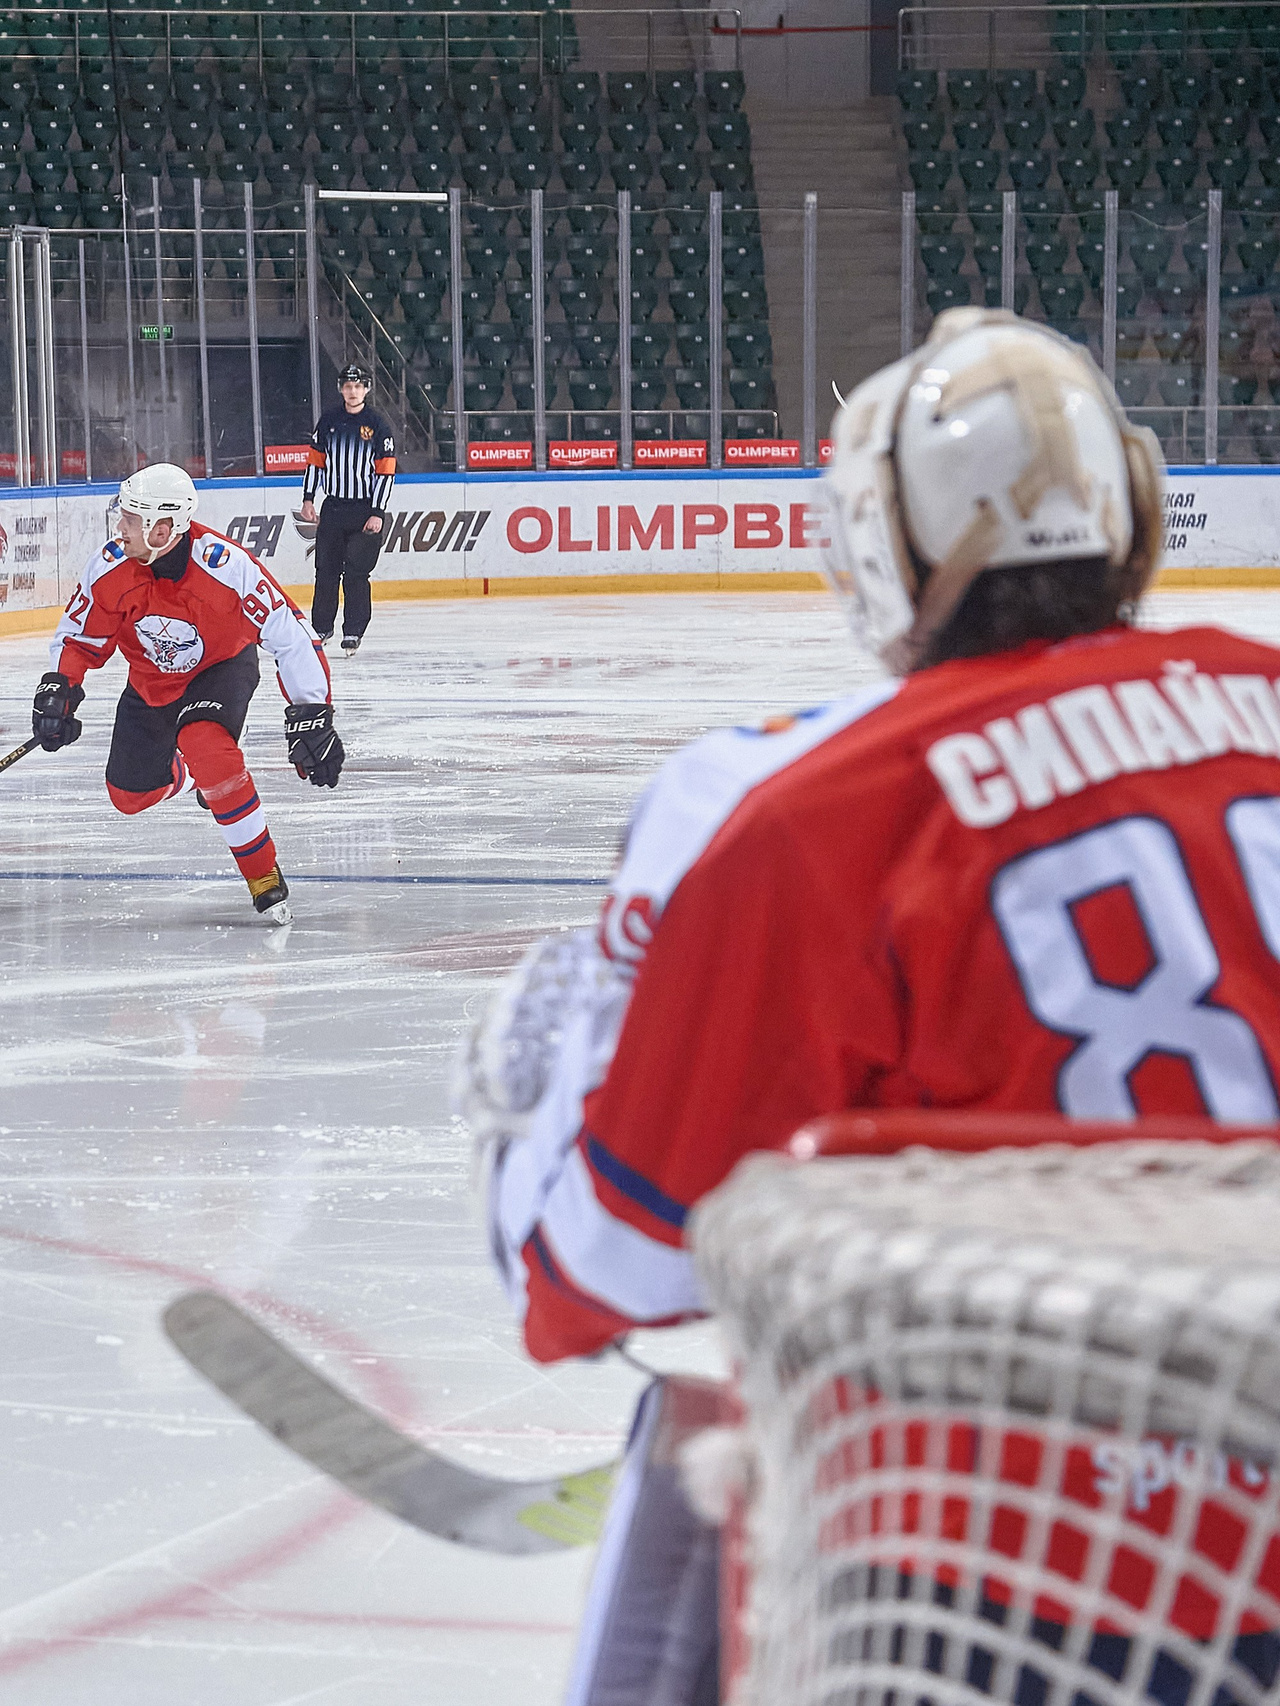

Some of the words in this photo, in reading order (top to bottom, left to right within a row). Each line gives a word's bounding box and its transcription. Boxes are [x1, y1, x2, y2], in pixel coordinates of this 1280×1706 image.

[469, 448, 531, 461] OLIMPBET
[551, 447, 615, 460] OLIMPBET
[636, 446, 705, 459] OLIMPBET
[727, 445, 798, 458] OLIMPBET
[381, 510, 492, 553] КОЛ!
[506, 502, 832, 554] OLIMPBE
[243, 579, 285, 625] 92
[285, 717, 326, 734] UER
[926, 658, 1280, 829] СИПАЙЛ
